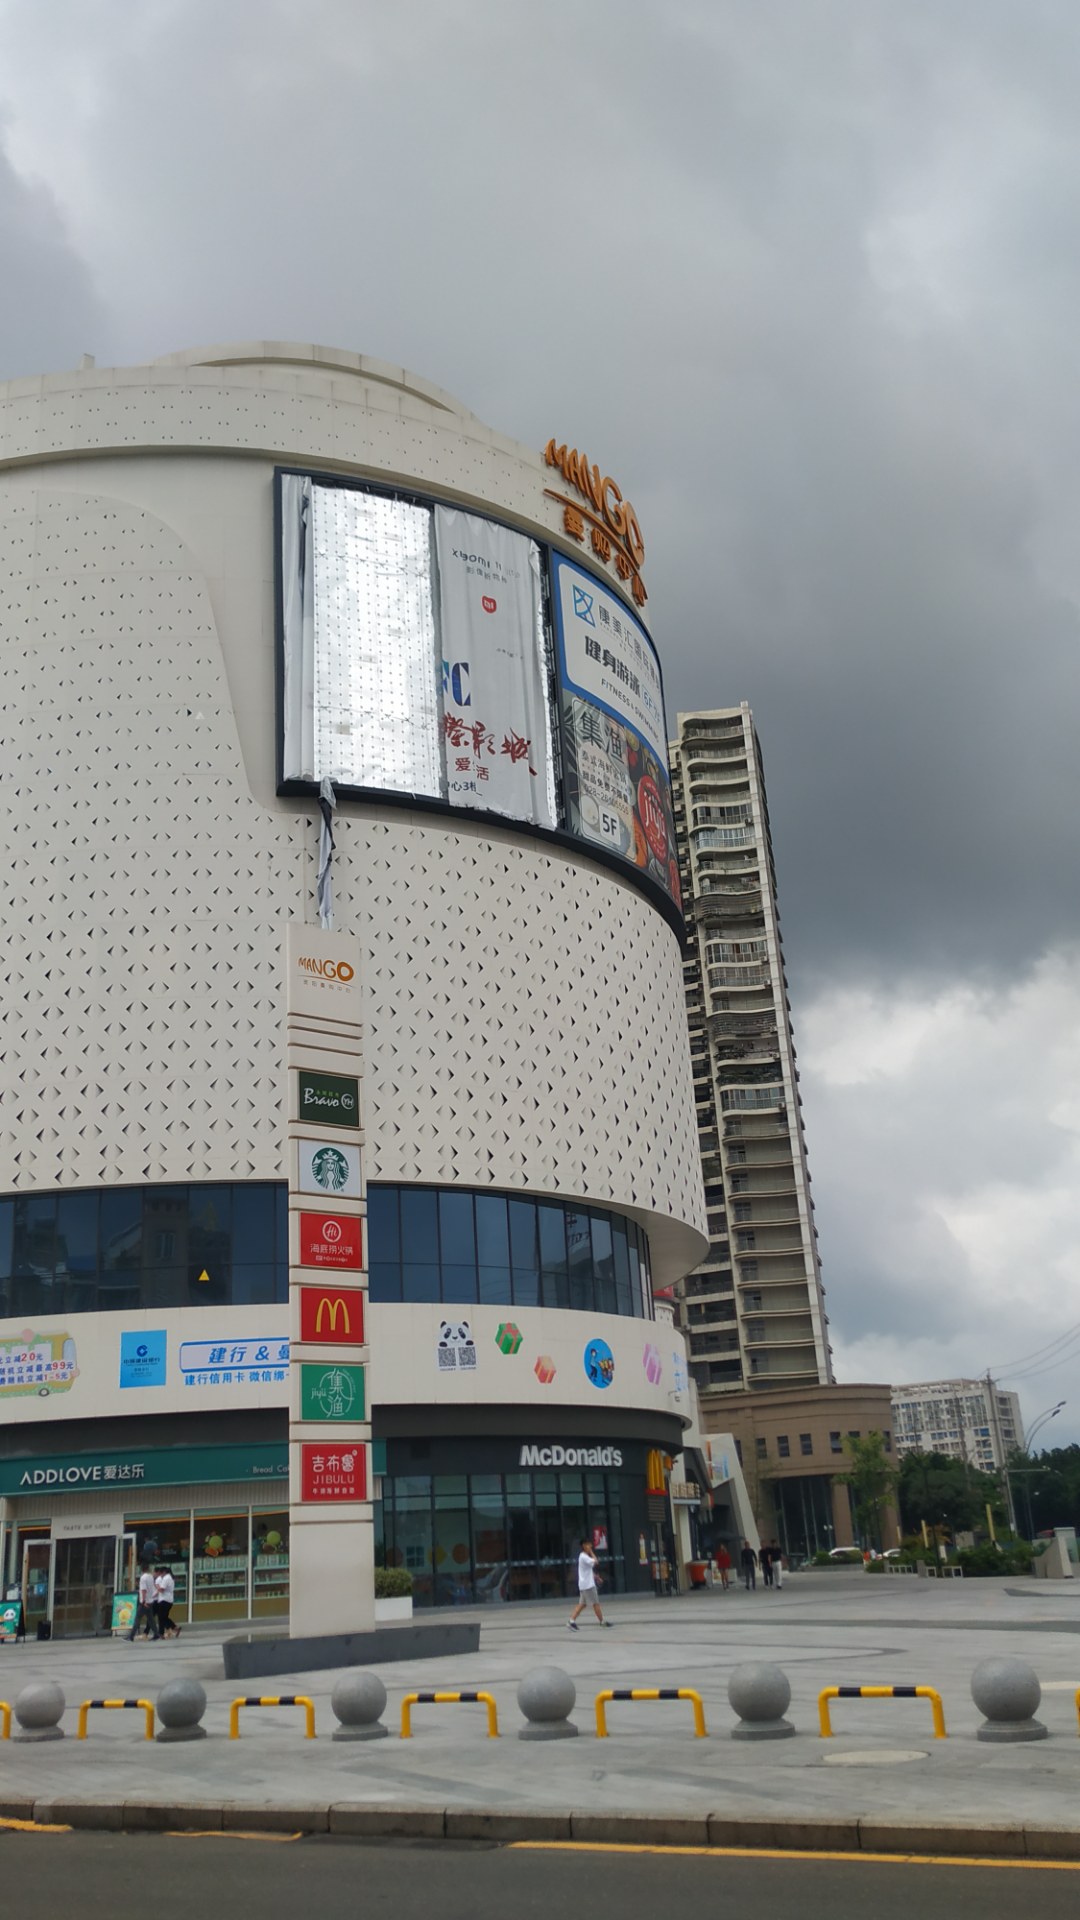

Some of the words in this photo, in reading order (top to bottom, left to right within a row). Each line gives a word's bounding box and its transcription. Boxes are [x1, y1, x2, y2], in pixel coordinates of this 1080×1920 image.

[545, 438, 645, 570] MANGO
[601, 677, 630, 706] FITNESS
[602, 813, 617, 837] 5F
[298, 956, 354, 982] MANGO
[303, 1087, 340, 1107] Bravo
[519, 1445, 623, 1467] McDonald's
[19, 1466, 102, 1486] ADDLOVE
[103, 1463, 145, 1481] 爱达乐
[252, 1465, 274, 1474] Bread
[312, 1474, 355, 1485] JIBULU
